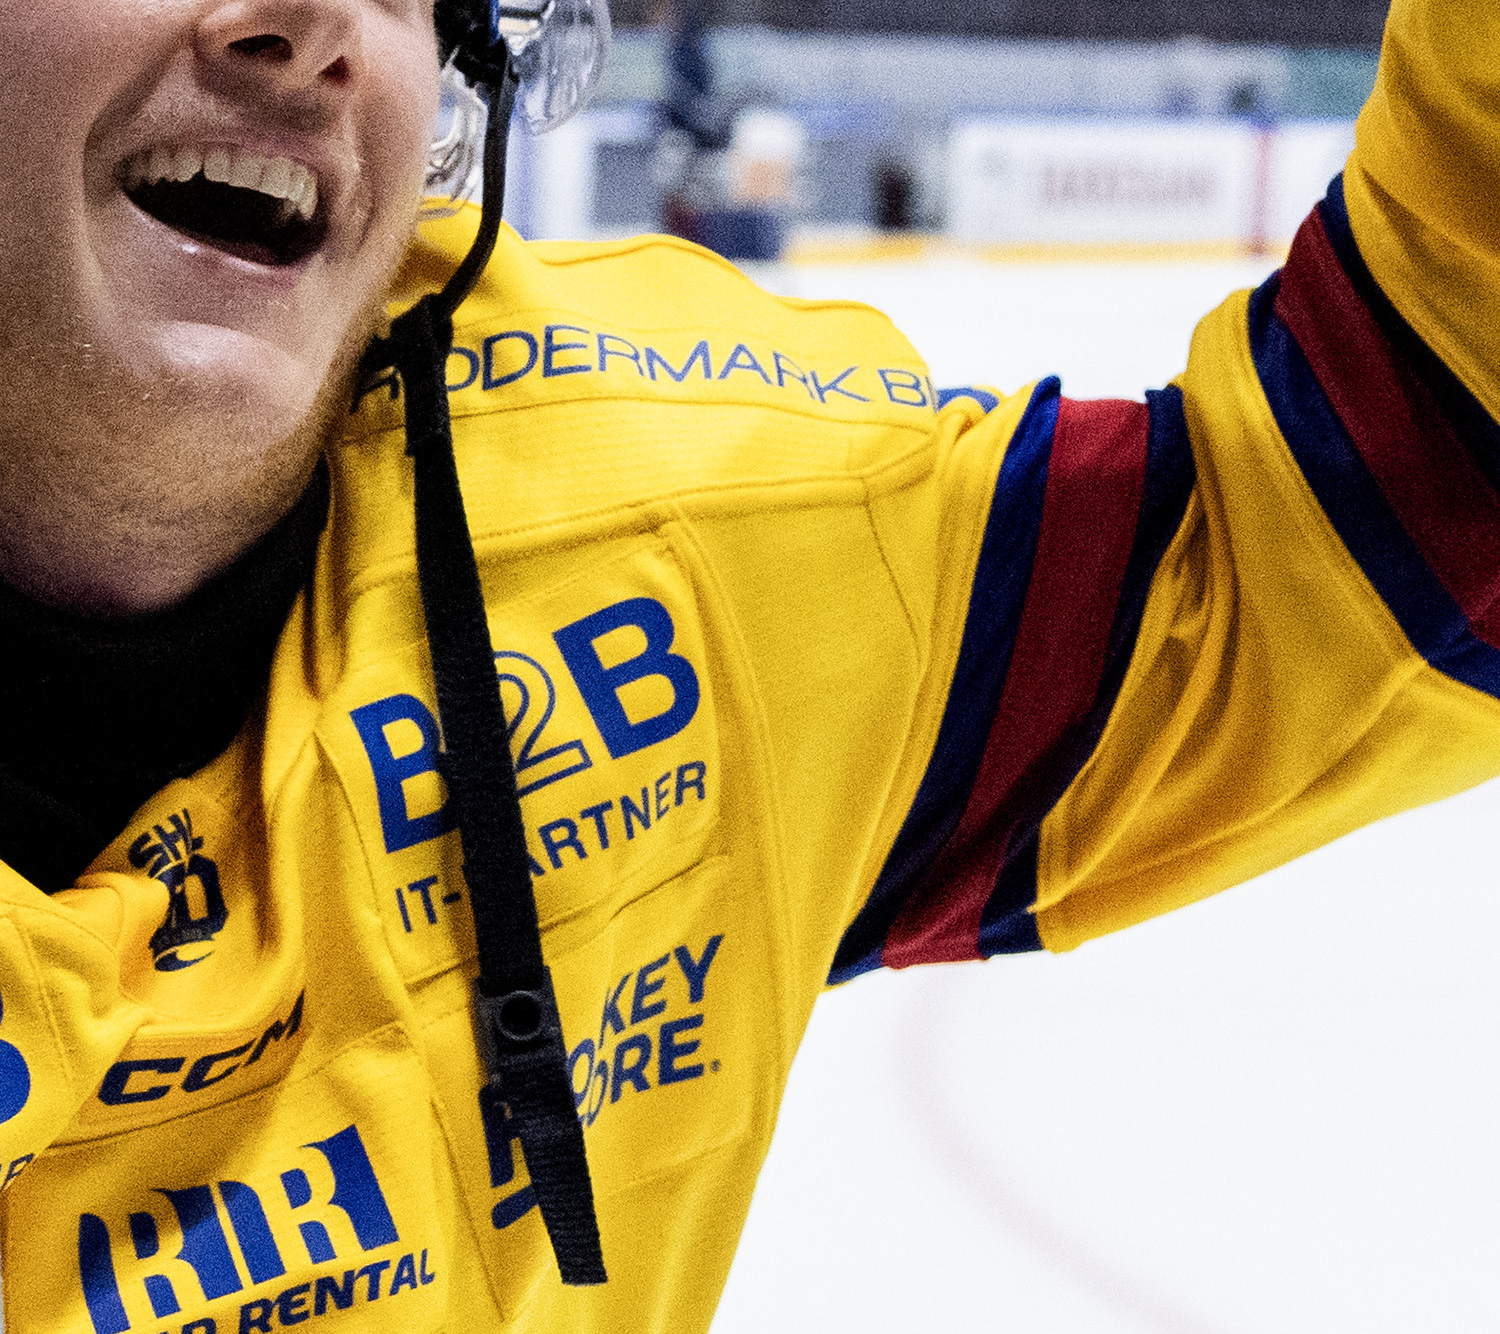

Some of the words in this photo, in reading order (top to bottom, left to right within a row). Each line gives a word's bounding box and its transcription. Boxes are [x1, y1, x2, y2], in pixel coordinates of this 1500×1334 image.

[350, 324, 871, 415] DDERMARK
[395, 759, 707, 933] IT-RTNER
[97, 989, 305, 1106] CCM
